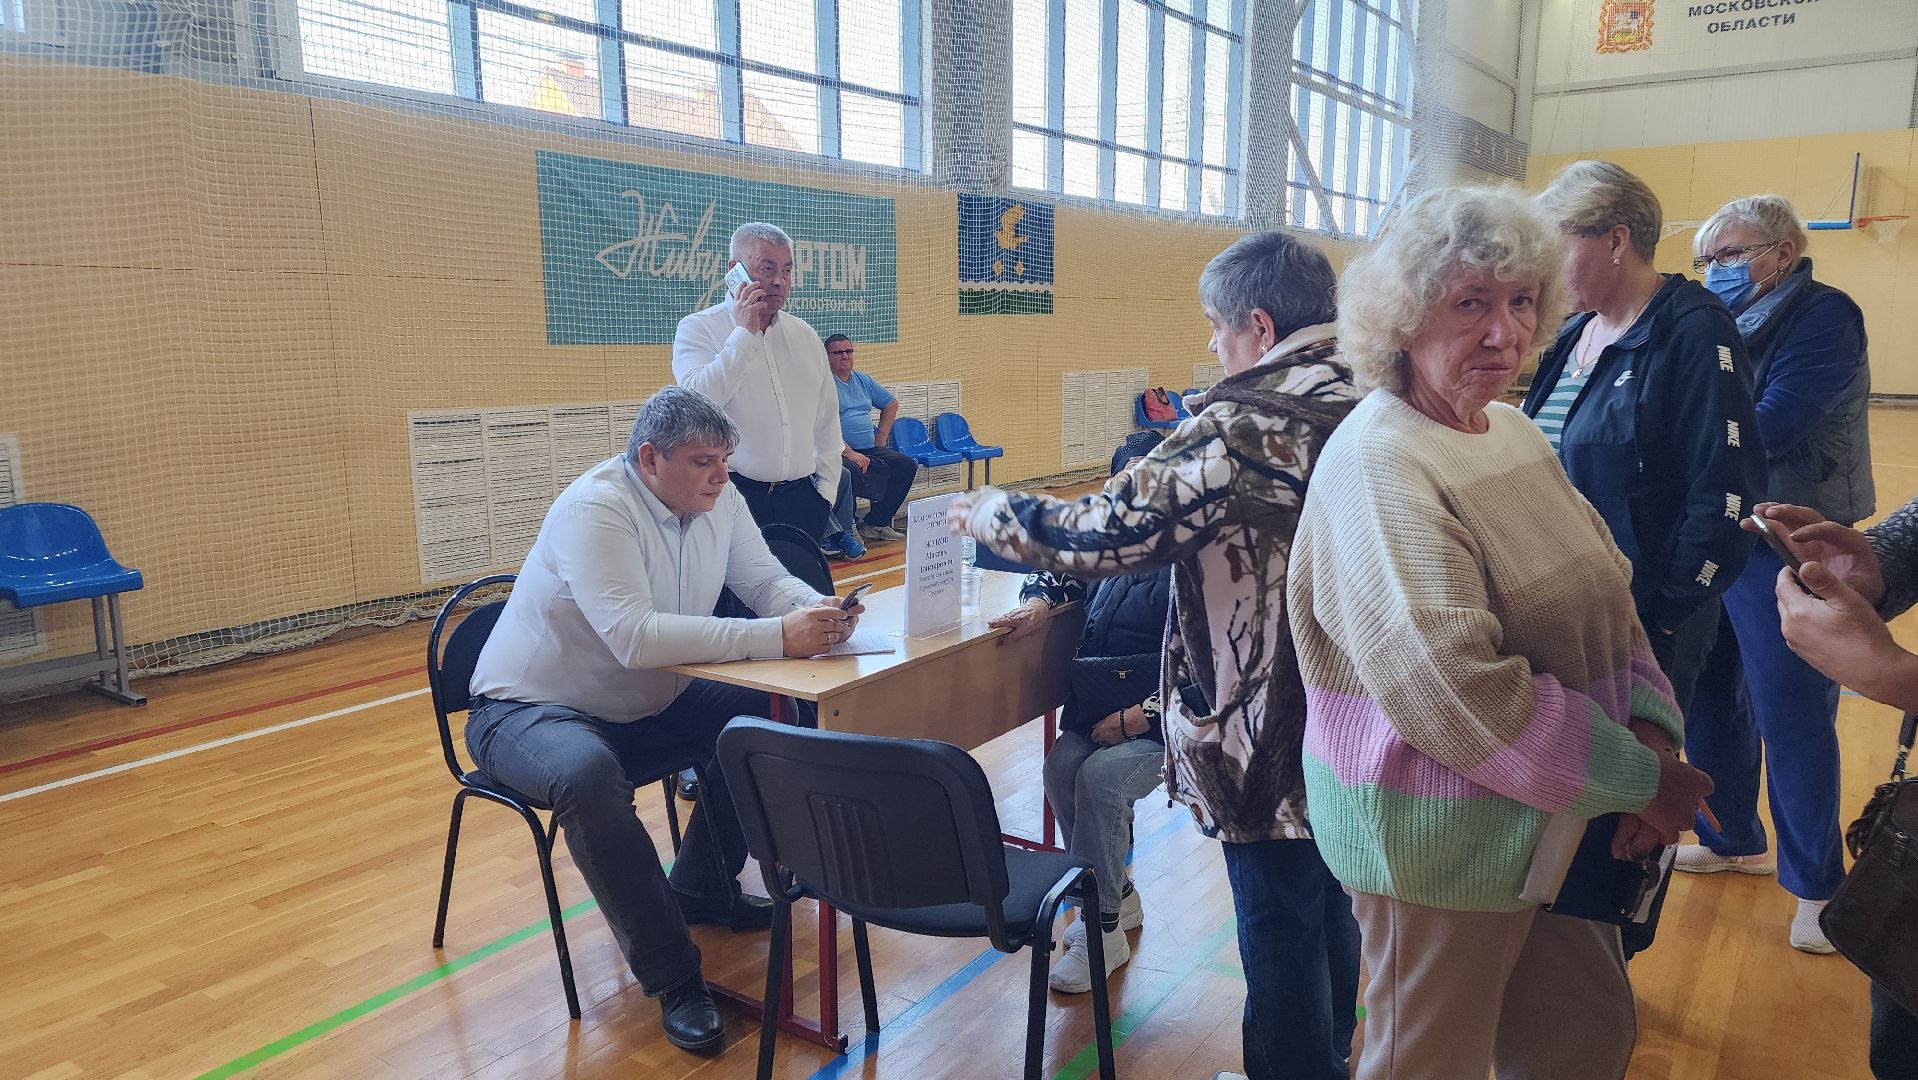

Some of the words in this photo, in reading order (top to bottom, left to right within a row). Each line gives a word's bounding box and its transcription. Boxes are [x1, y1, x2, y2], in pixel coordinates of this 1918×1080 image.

[1688, 0, 1821, 17] МОСКОВСК
[1707, 13, 1796, 34] ОБЛАСТИ
[595, 189, 727, 312] Живу
[791, 240, 866, 290] РТОМ
[1716, 345, 1734, 373] NIKE
[1727, 419, 1740, 448] NIKE
[1724, 492, 1742, 521] NIKE
[925, 536, 949, 549] ЖУКОВ
[1695, 559, 1720, 587] NIKE
